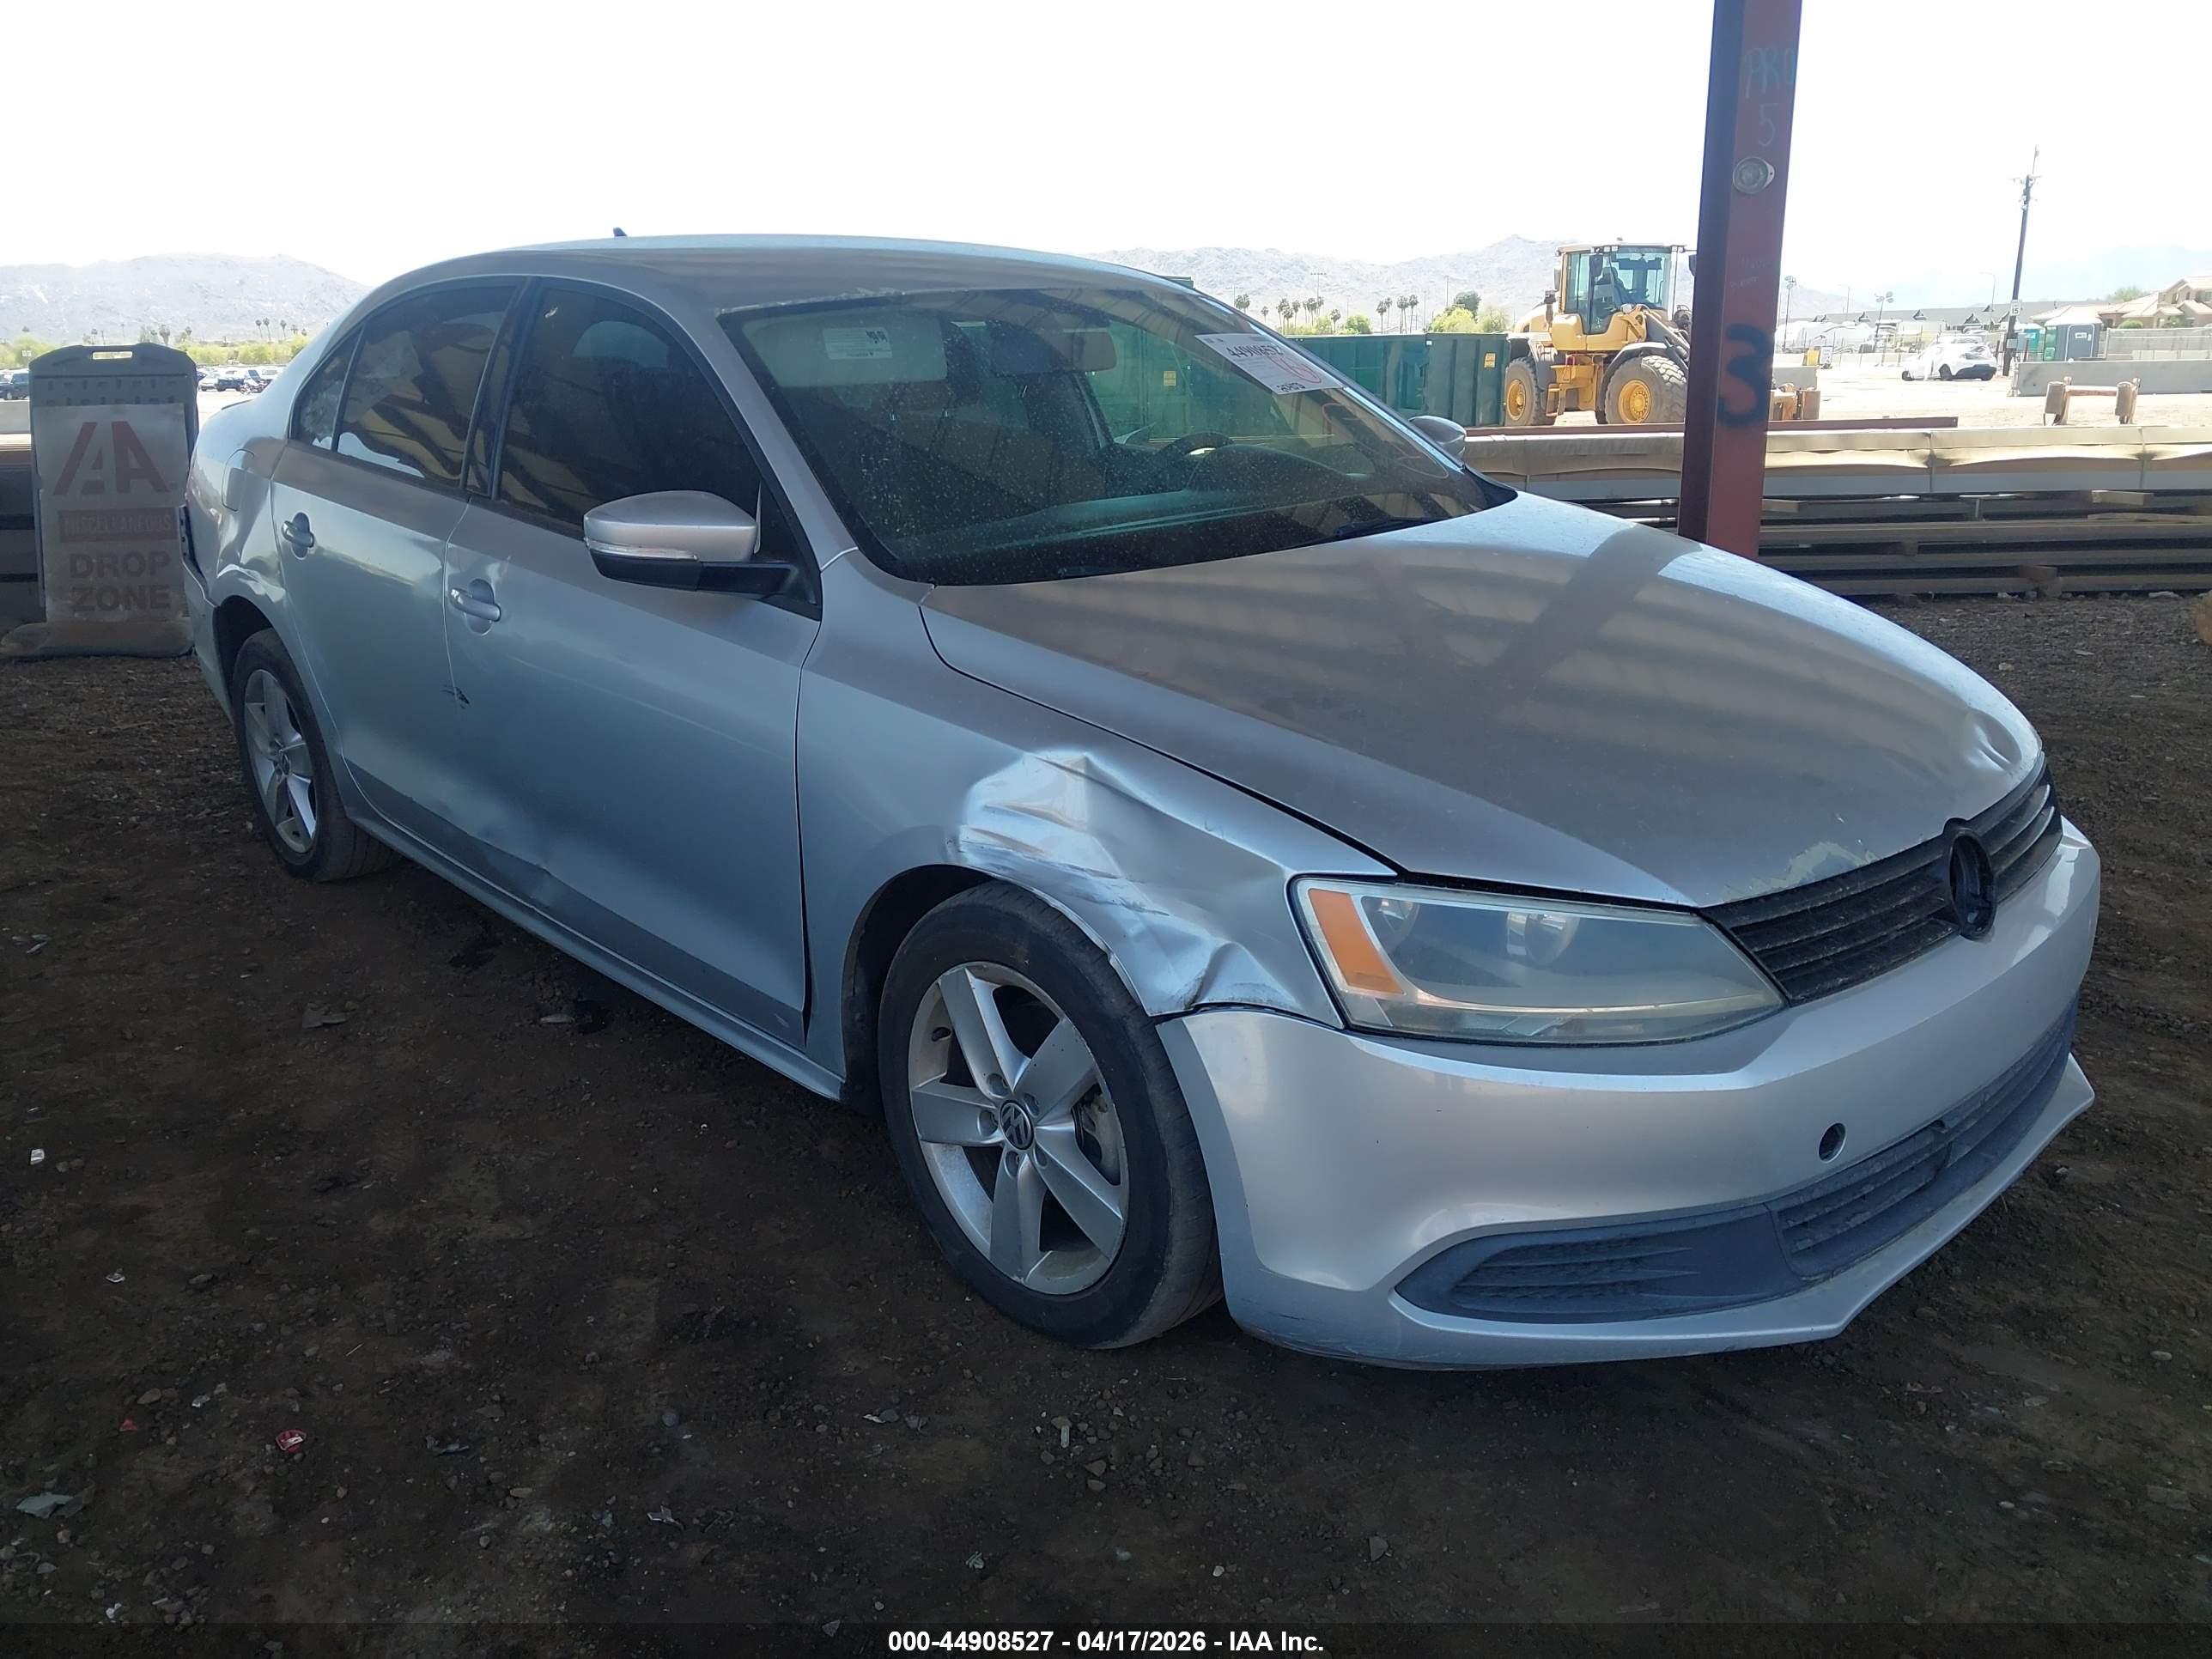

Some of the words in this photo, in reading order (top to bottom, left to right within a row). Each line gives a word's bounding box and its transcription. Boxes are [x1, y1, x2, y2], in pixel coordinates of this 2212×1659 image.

[1717, 323, 1771, 427] 3
[70, 551, 171, 579] DROP
[70, 583, 172, 612] ZONE
